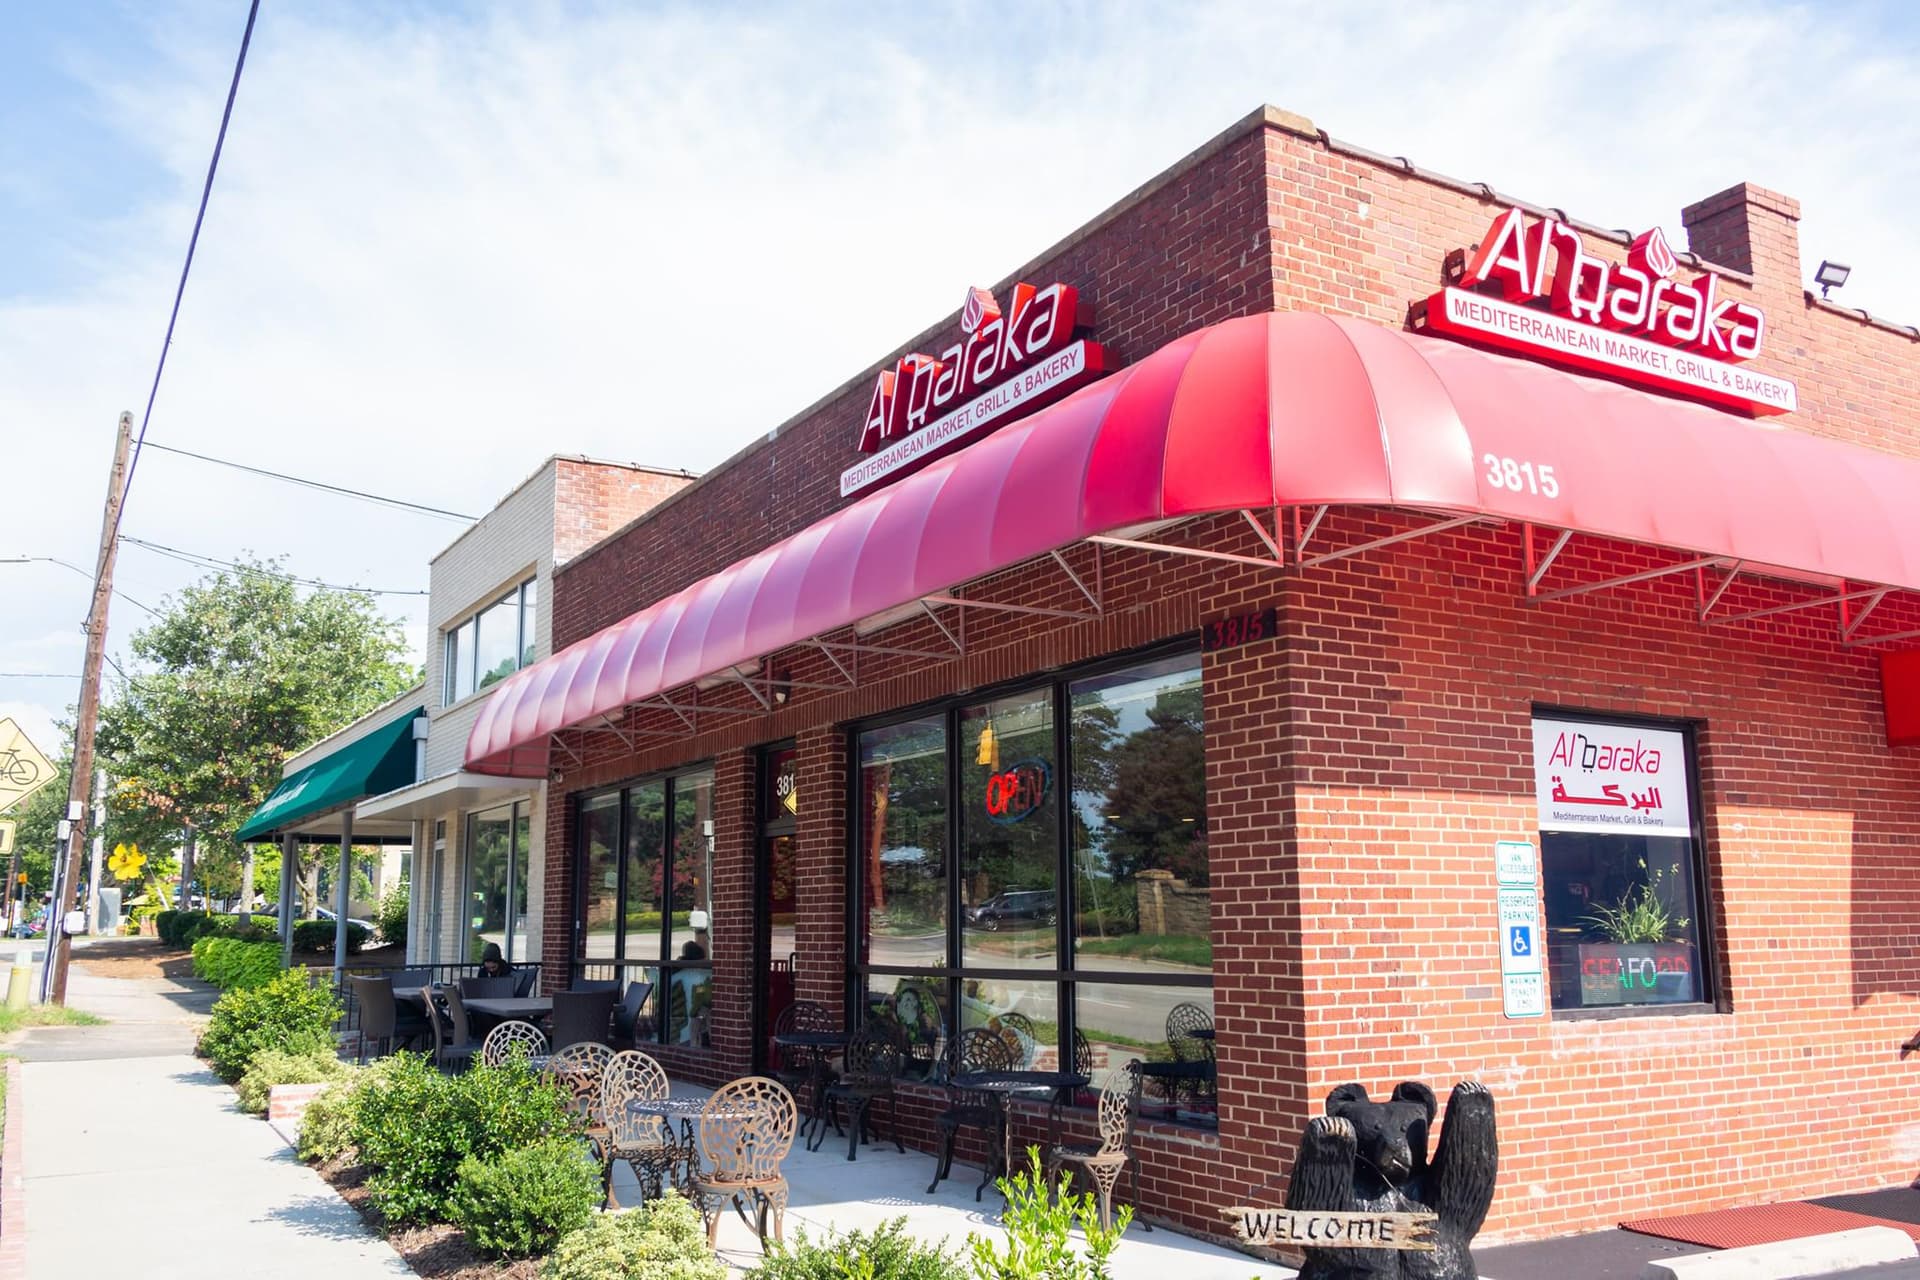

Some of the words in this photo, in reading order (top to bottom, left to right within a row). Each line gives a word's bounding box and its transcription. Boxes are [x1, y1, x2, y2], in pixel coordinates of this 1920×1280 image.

[1454, 298, 1600, 353] MEDITERRANEAN
[1605, 339, 1673, 374] MARKET,
[1675, 359, 1718, 384] GRILL
[1722, 370, 1731, 388] &
[1735, 374, 1788, 402] BAKERY
[844, 434, 923, 490] MEDITERRANEAN
[926, 409, 972, 447] MARKET,
[975, 389, 1009, 418] GRILL
[1013, 381, 1022, 398] &
[1025, 348, 1079, 391] BAKERY
[1483, 453, 1559, 499] 3815
[1211, 611, 1264, 650] 3815
[986, 766, 1044, 816] OPEN
[1553, 811, 1599, 822] Mediterranean
[1624, 815, 1636, 824] Grill
[1643, 816, 1664, 827] Bakery
[1500, 895, 1535, 908] RESERVED
[1503, 910, 1535, 922] PARKING
[1244, 1212, 1393, 1242] WELCOME
